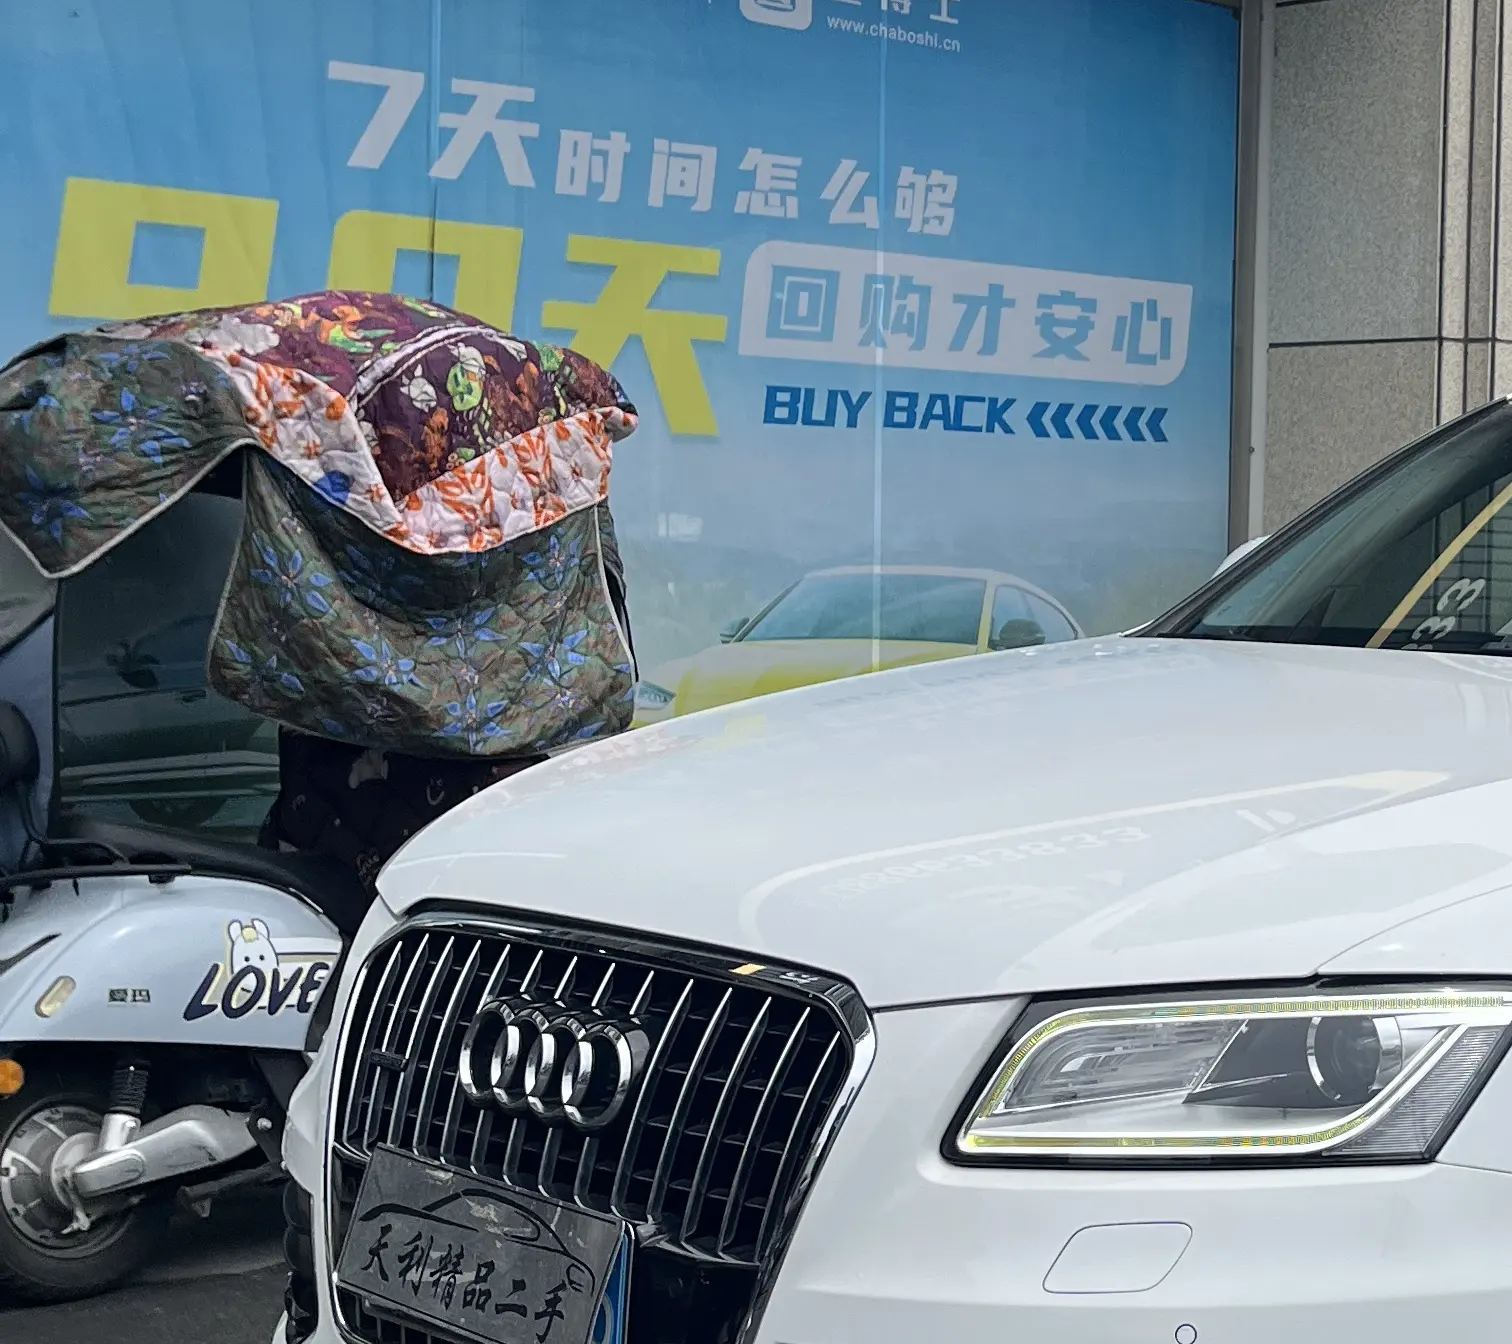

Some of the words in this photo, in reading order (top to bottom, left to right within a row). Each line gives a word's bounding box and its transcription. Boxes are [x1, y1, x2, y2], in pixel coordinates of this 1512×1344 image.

[826, 14, 961, 53] www.chaboshi.cn
[326, 60, 959, 237] 7天时间怎么够
[763, 262, 1174, 366] 回购才安心
[762, 384, 872, 429] BUY
[882, 390, 1017, 435] BACK
[183, 961, 331, 1022] LOVE
[360, 1222, 571, 1344] 天利精品二手
